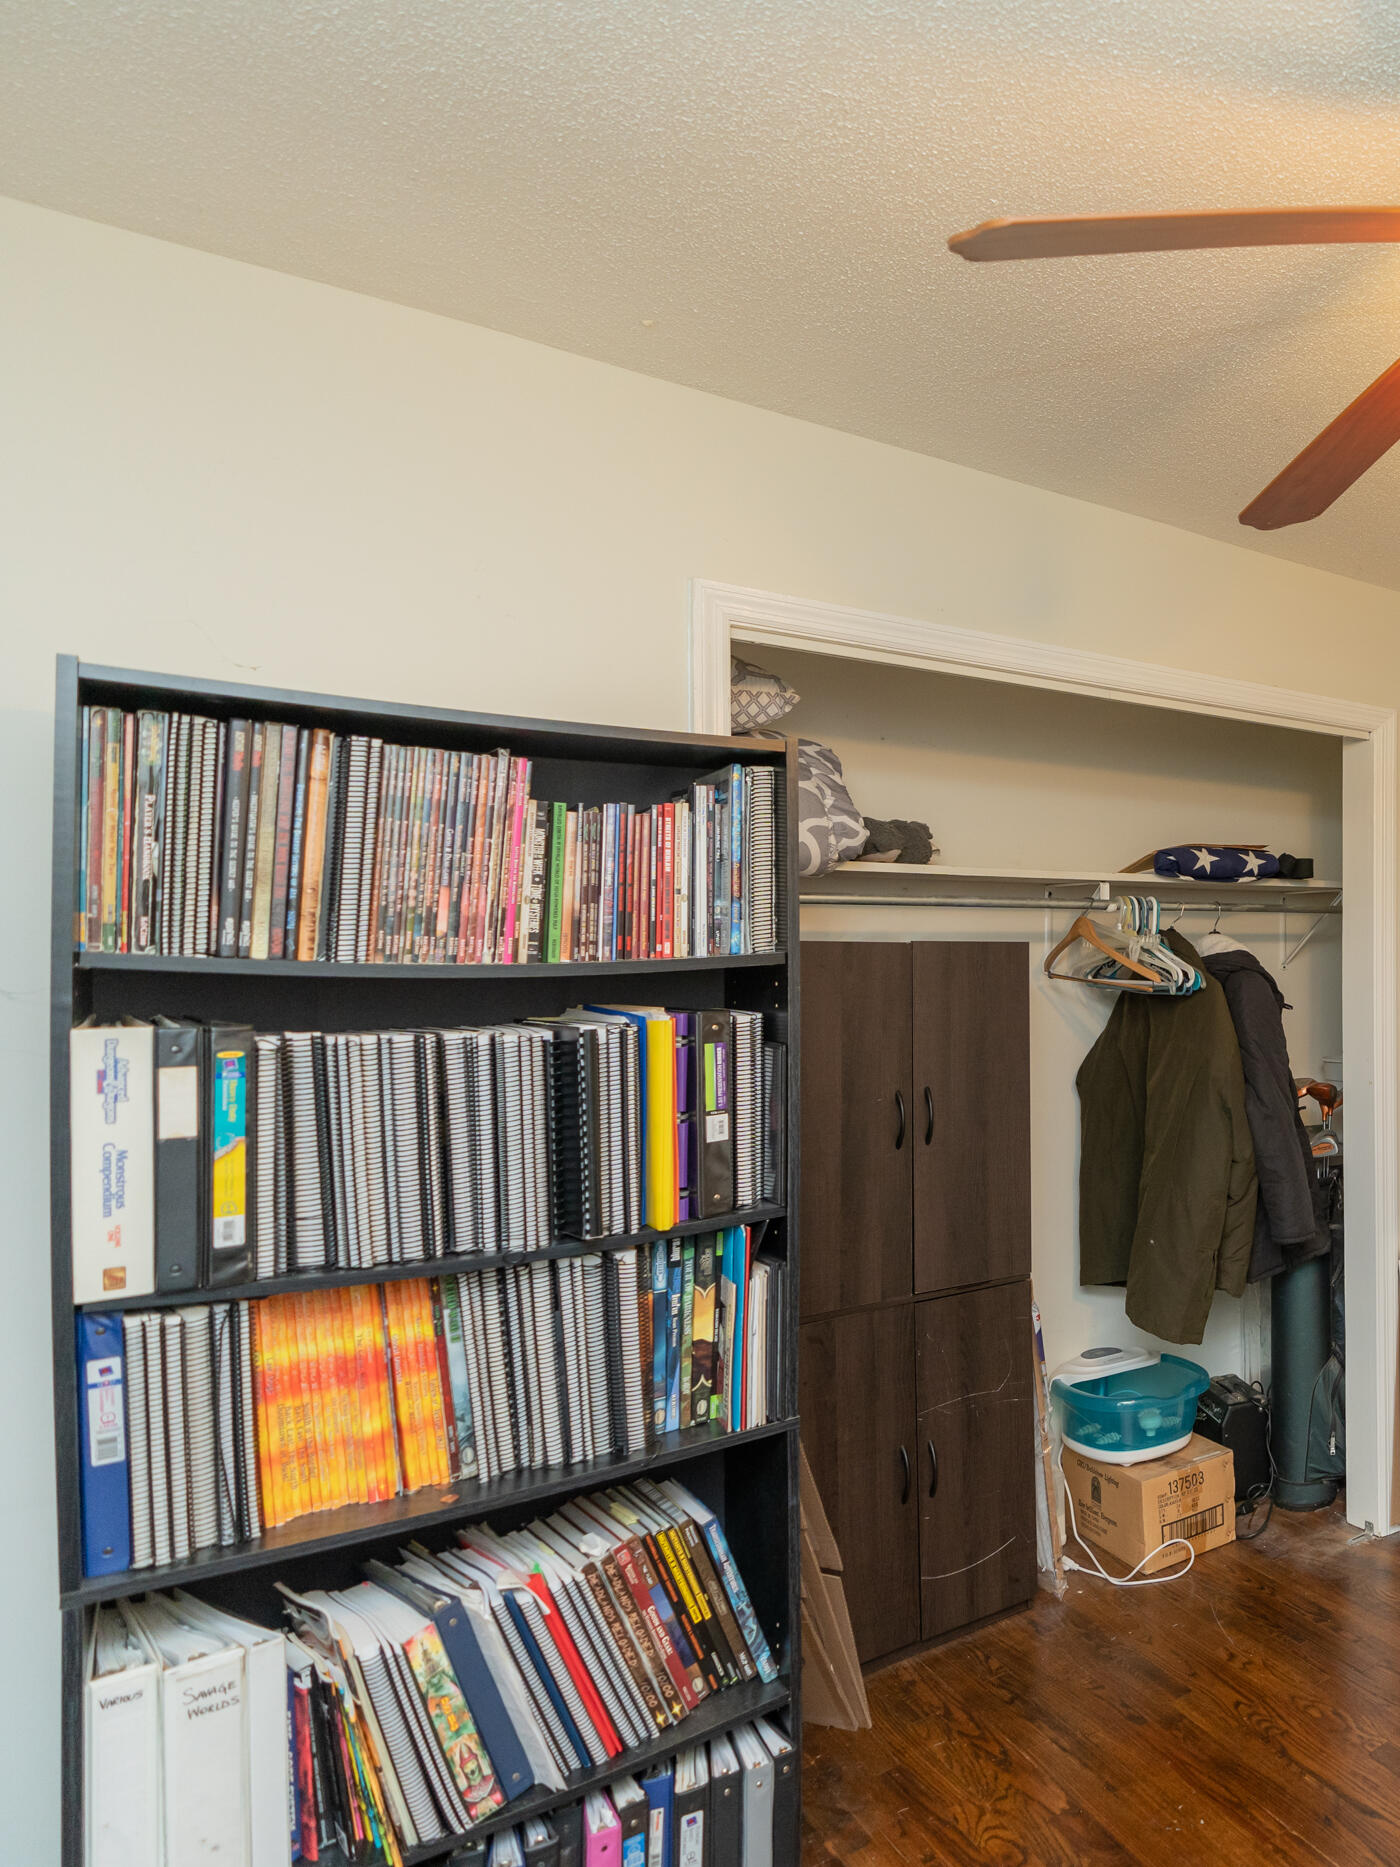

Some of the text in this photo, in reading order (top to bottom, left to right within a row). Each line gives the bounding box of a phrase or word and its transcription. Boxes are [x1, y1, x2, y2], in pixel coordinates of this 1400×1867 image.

[533, 859, 544, 875] WEEK
[99, 1142, 115, 1219] Compendium
[115, 1149, 129, 1209] Monstrous
[684, 1260, 693, 1335] TOUR OF DARKNESS
[1168, 1471, 1204, 1495] 137503
[587, 1573, 638, 1666] DEADLANDS RELOADED
[605, 1564, 634, 1611] DEADLANDS
[629, 1614, 655, 1656] RELOADED
[99, 1689, 144, 1710] VARIOUS
[183, 1680, 237, 1705] SAVAGE
[187, 1695, 240, 1720] WORLDS
